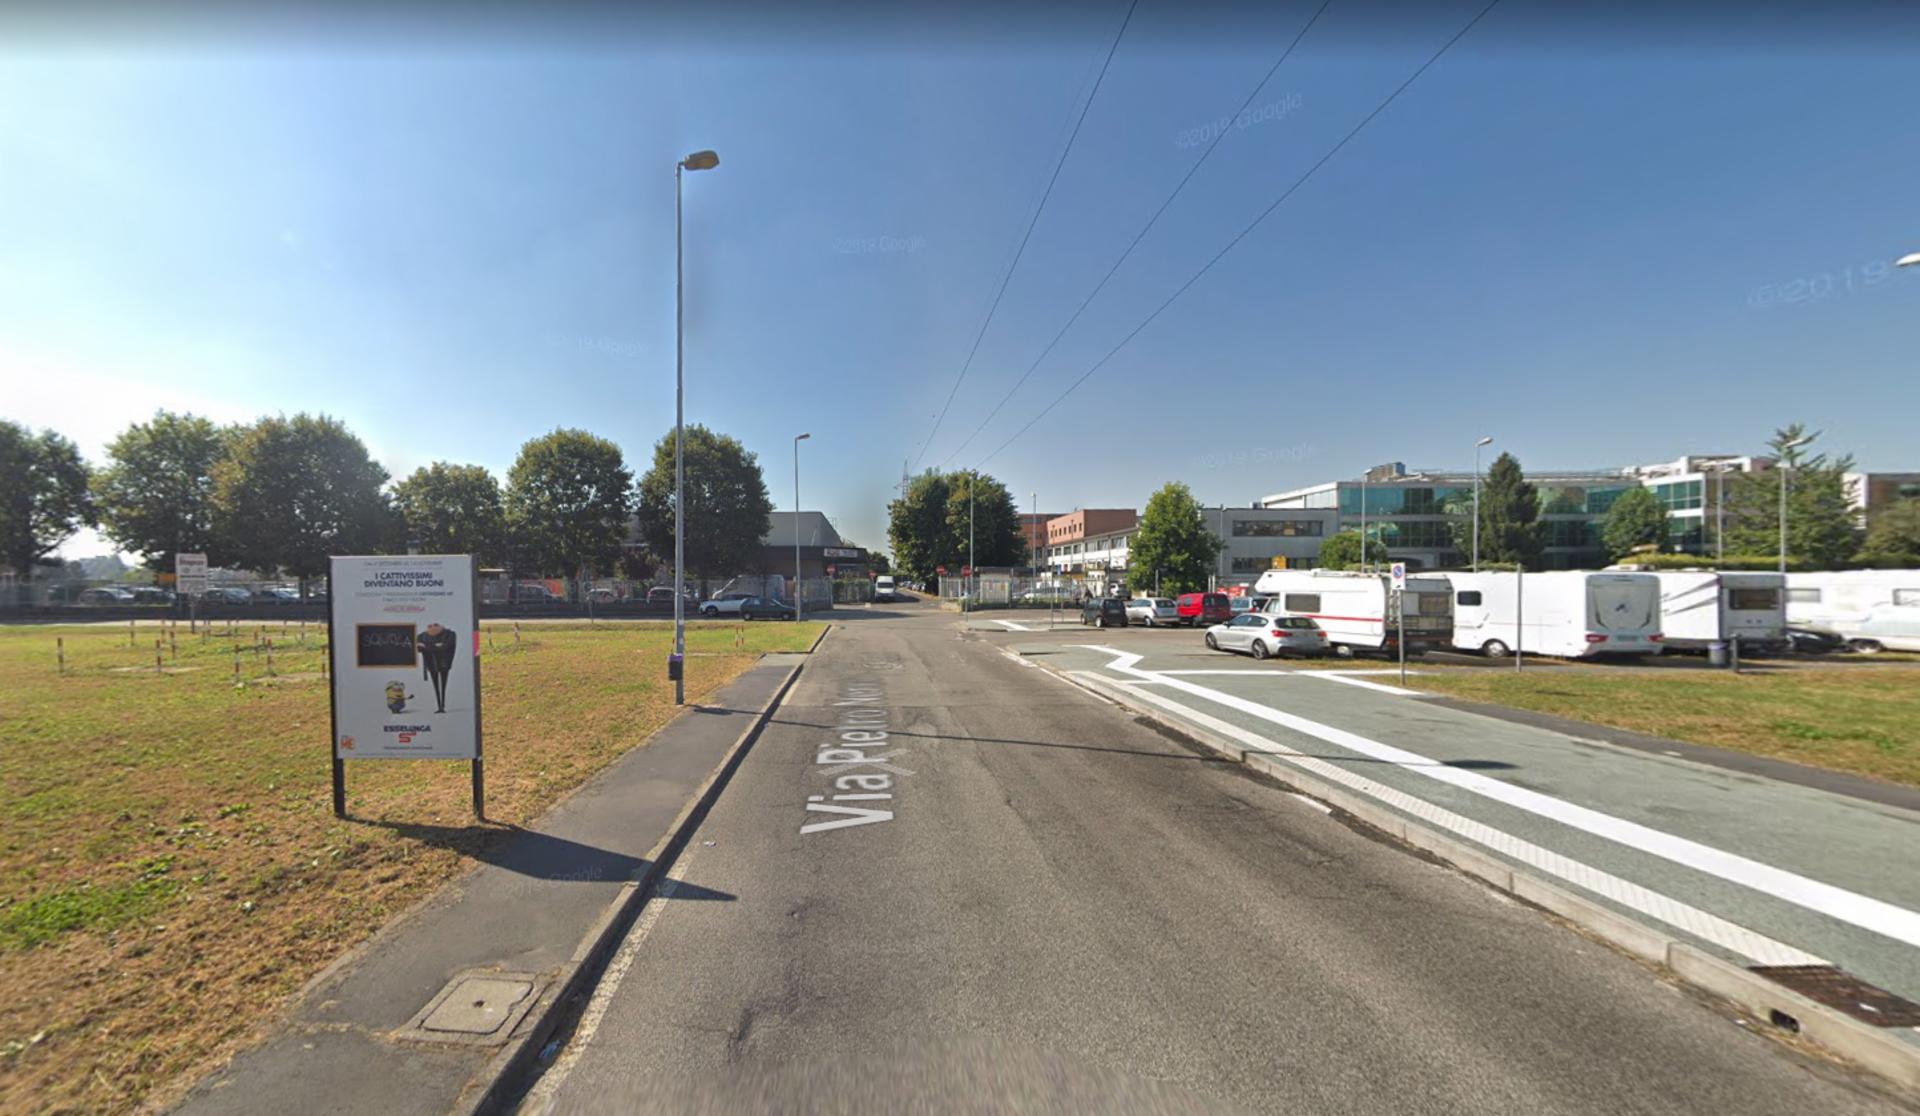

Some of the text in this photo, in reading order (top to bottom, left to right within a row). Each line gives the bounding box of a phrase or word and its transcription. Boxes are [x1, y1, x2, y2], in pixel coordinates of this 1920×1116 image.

[380, 572, 433, 580] CATTIVISSIMI
[364, 580, 444, 588] DIVENTANO BUONI
[383, 725, 432, 733] ESSELUNGA
[816, 709, 889, 765] Pietro
[800, 774, 893, 834] Via
